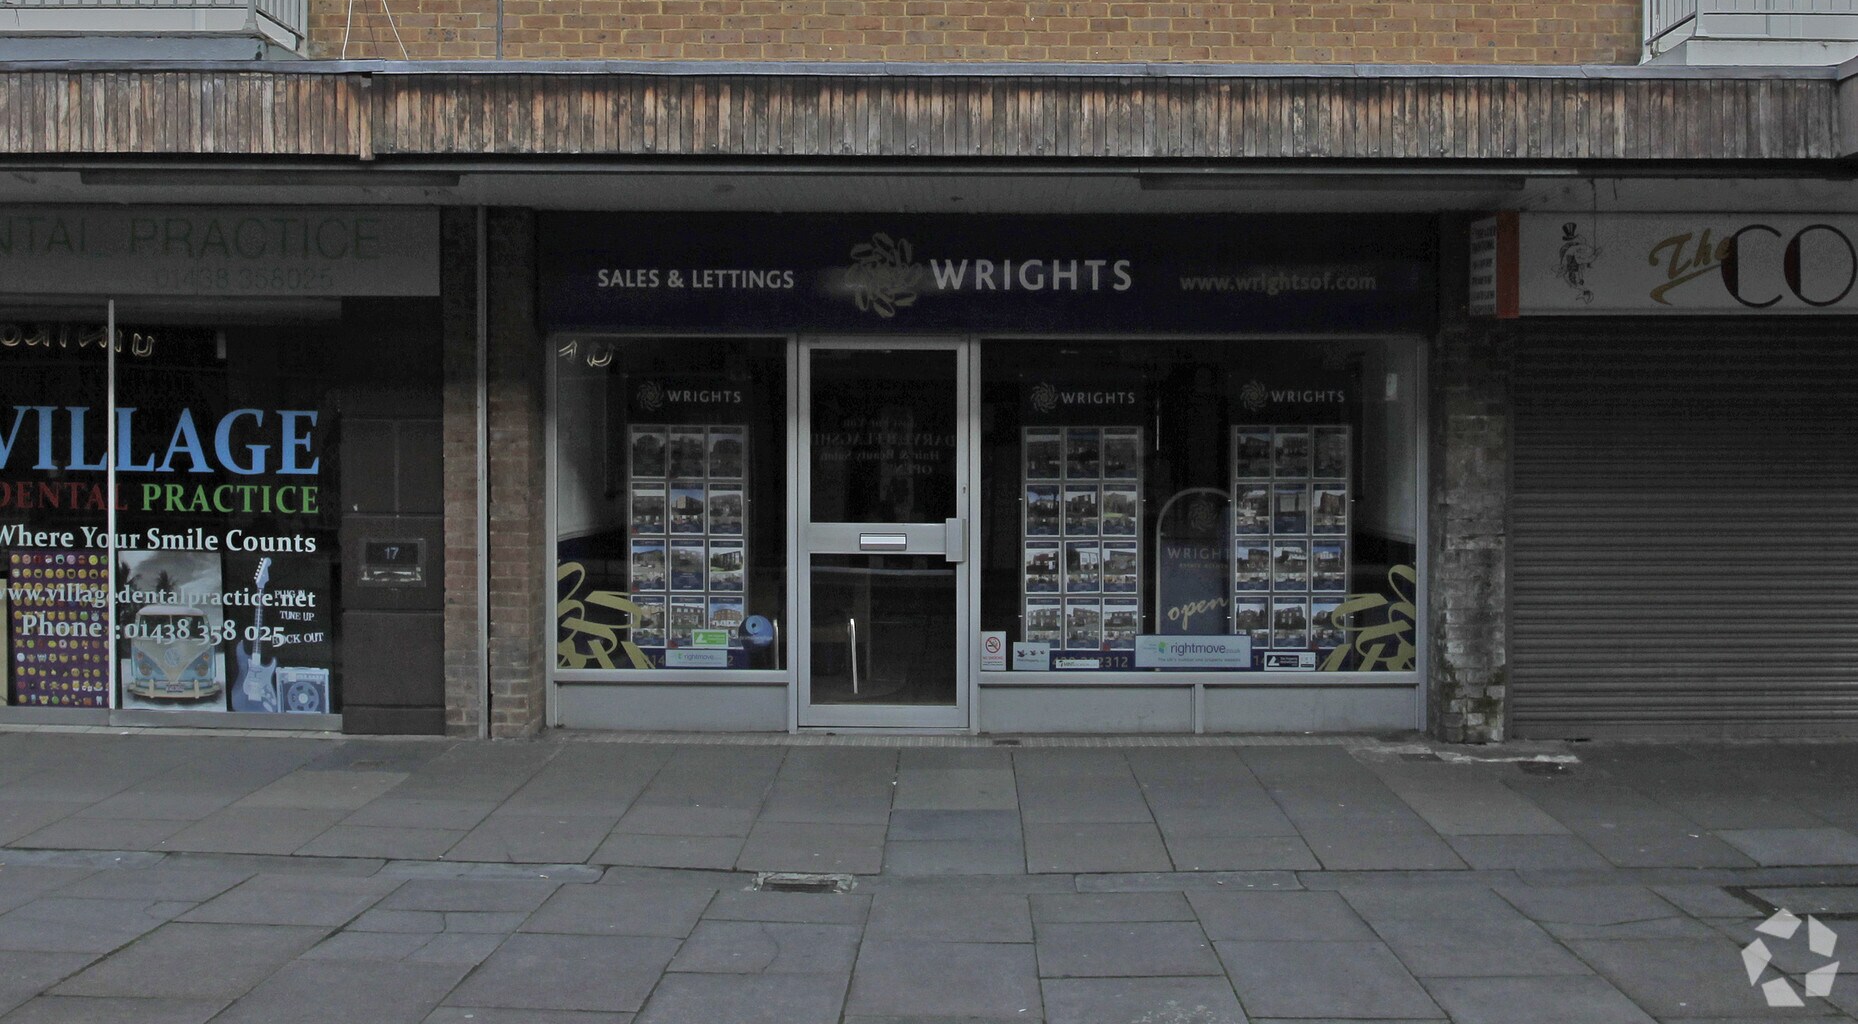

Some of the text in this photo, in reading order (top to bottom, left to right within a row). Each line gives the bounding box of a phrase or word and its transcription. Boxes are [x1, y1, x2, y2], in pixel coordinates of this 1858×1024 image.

[129, 217, 381, 260] PRACTICE
[930, 259, 1133, 292] WRIGHTS
[1721, 224, 1858, 308] CO
[598, 268, 795, 290] SALES & LETTINGS
[1180, 272, 1377, 295] www.wrightsof.com
[667, 390, 742, 403] WRIGHTS
[1061, 390, 1135, 405] WRIGHTS
[1271, 389, 1346, 404] WRIGHTS
[141, 483, 320, 514] PRACTICE
[0, 524, 317, 553] Where Your Smile Counts
[384, 546, 399, 560] 17
[280, 610, 315, 622] TUNE UP
[1167, 597, 1229, 631] open
[199, 619, 237, 646] 358
[244, 625, 285, 648] 025
[303, 632, 324, 644] OUT
